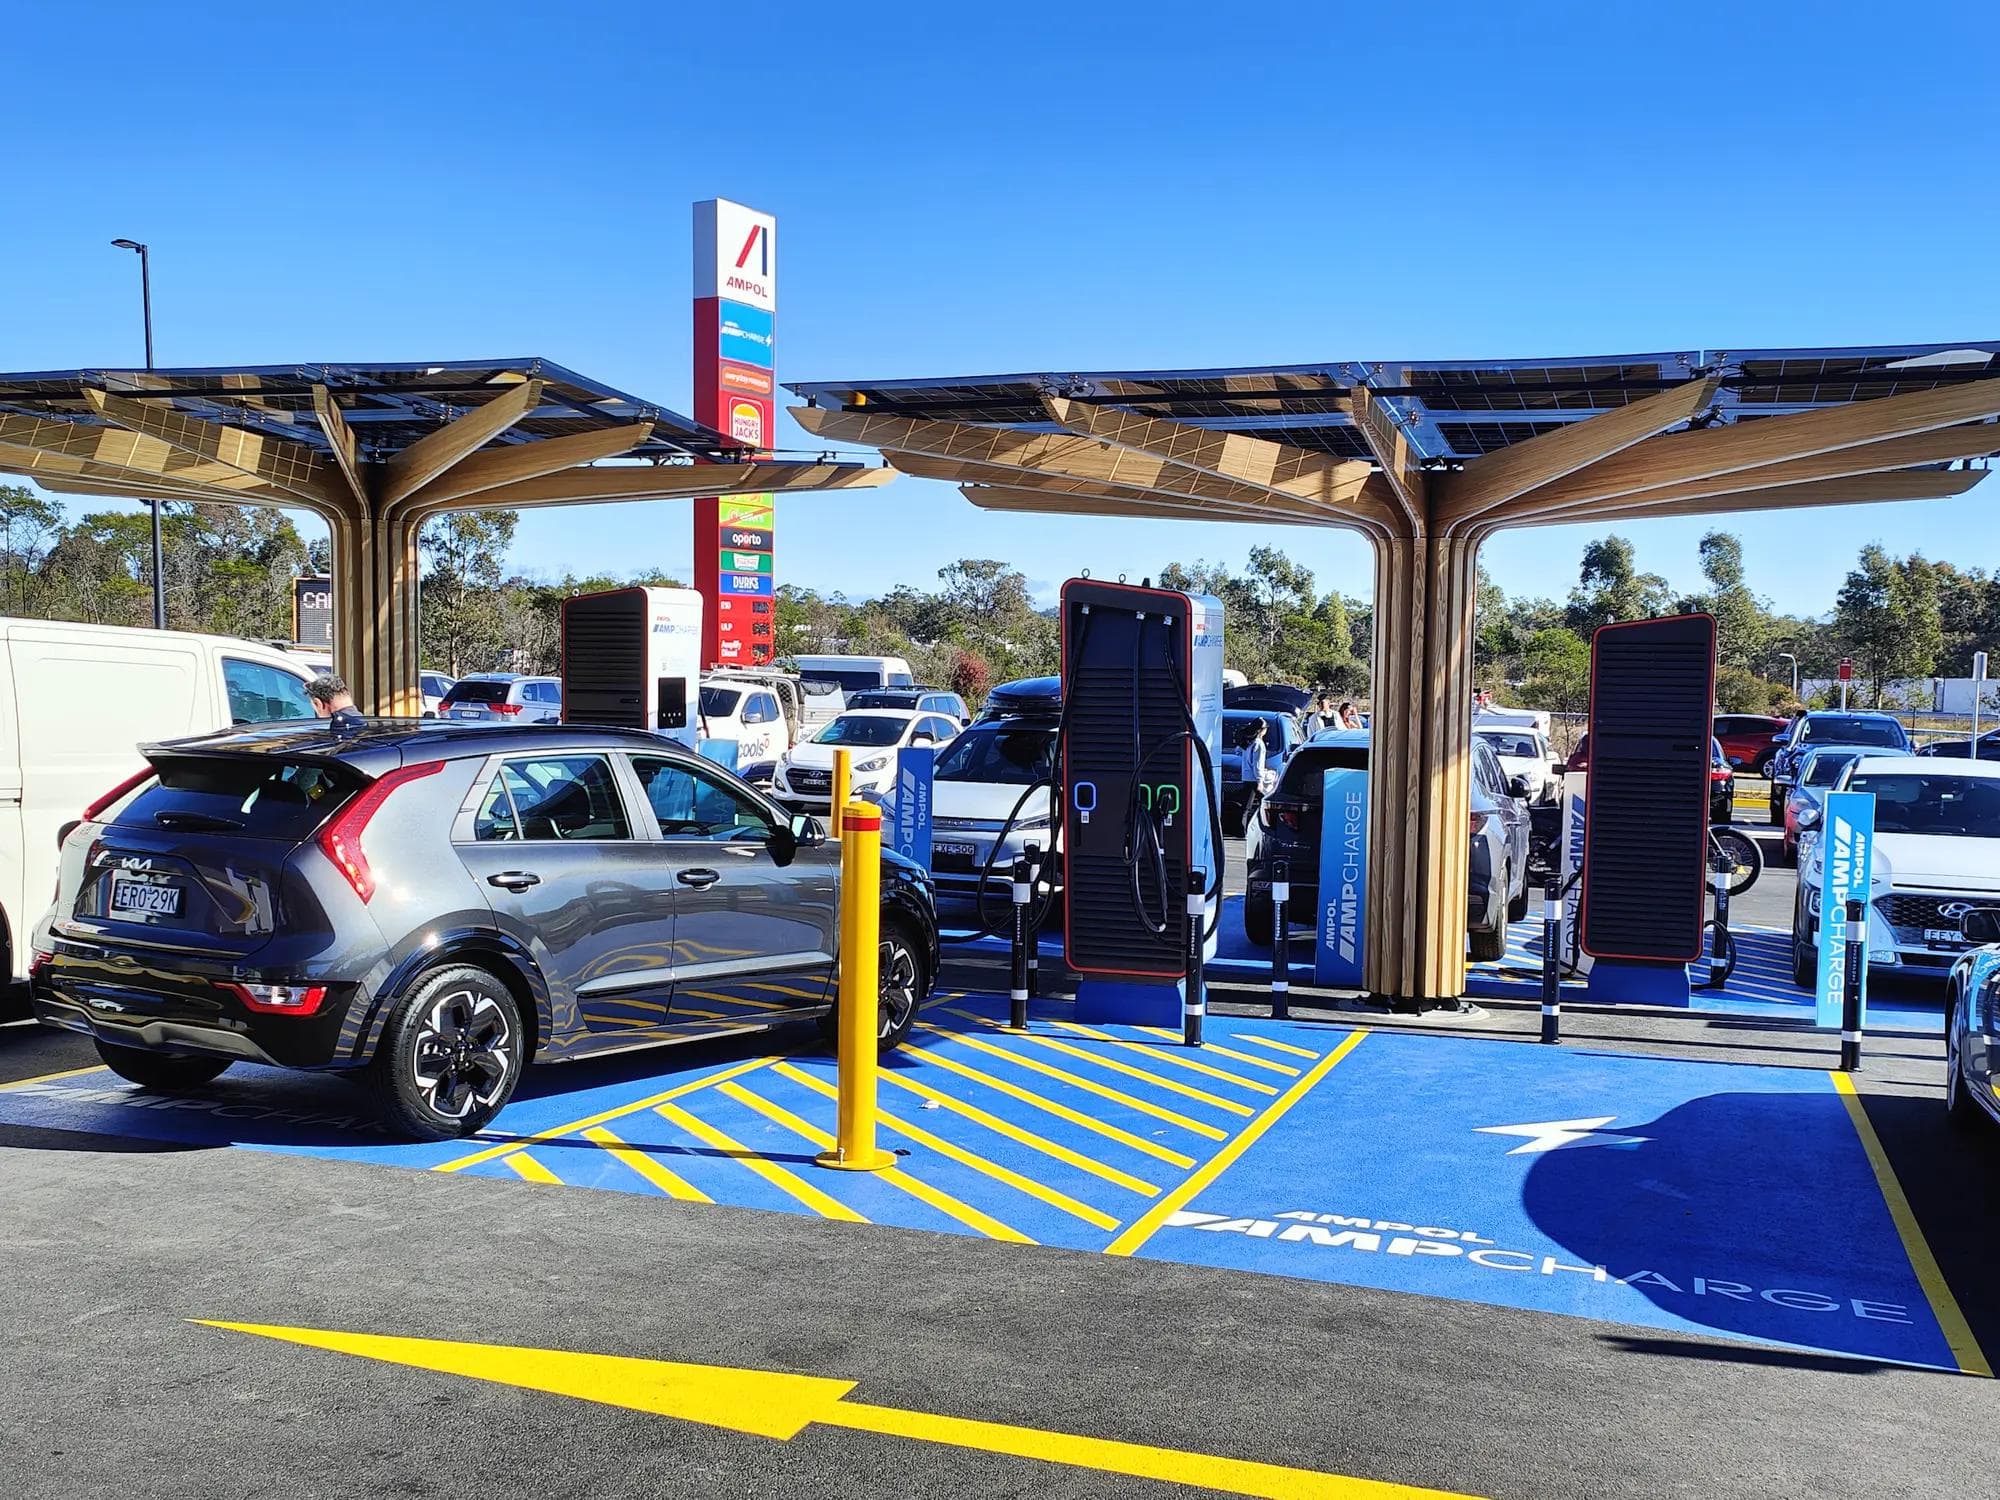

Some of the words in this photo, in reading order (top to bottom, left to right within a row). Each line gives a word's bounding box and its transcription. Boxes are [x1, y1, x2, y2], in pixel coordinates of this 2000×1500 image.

[726, 276, 768, 298] AMPOL
[732, 533, 762, 546] oporto
[303, 592, 333, 609] CA
[918, 781, 927, 830] AMPOL
[1339, 791, 1362, 950] AMPCHARGE
[1851, 831, 1866, 889] AMPOL
[1325, 898, 1337, 950] AMPOL
[1826, 836, 1851, 1004] AMPCHARGE
[1272, 1210, 1495, 1245] AMPOL
[1194, 1217, 1914, 1325] AMPCHARGE
